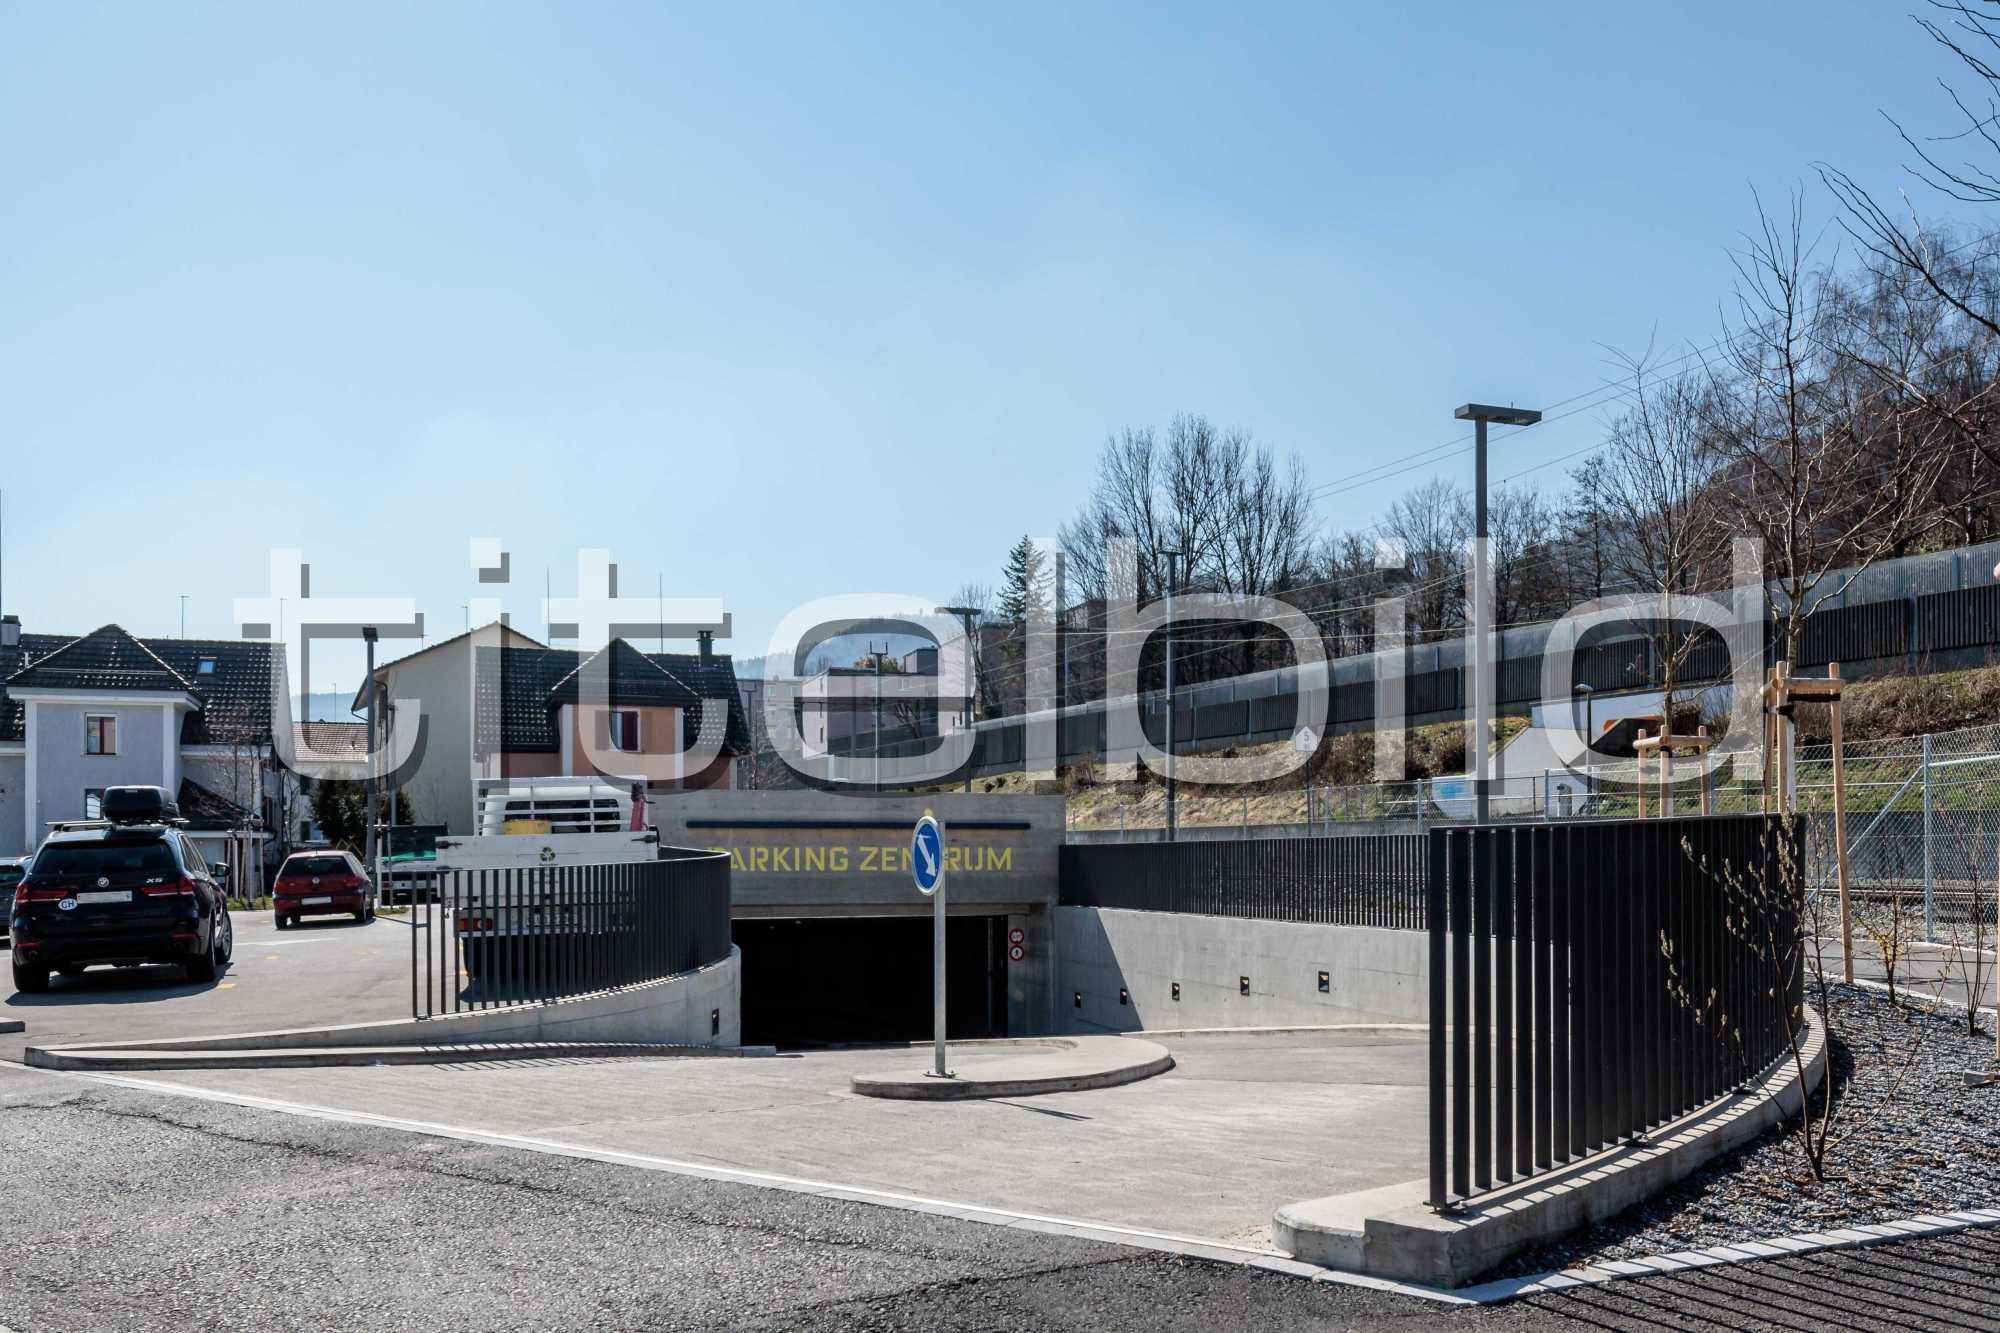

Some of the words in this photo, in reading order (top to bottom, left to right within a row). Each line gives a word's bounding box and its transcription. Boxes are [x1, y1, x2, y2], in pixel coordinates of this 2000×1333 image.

[707, 846, 849, 873] ARKING
[859, 846, 1012, 873] ZENRUM
[61, 900, 75, 909] CH
